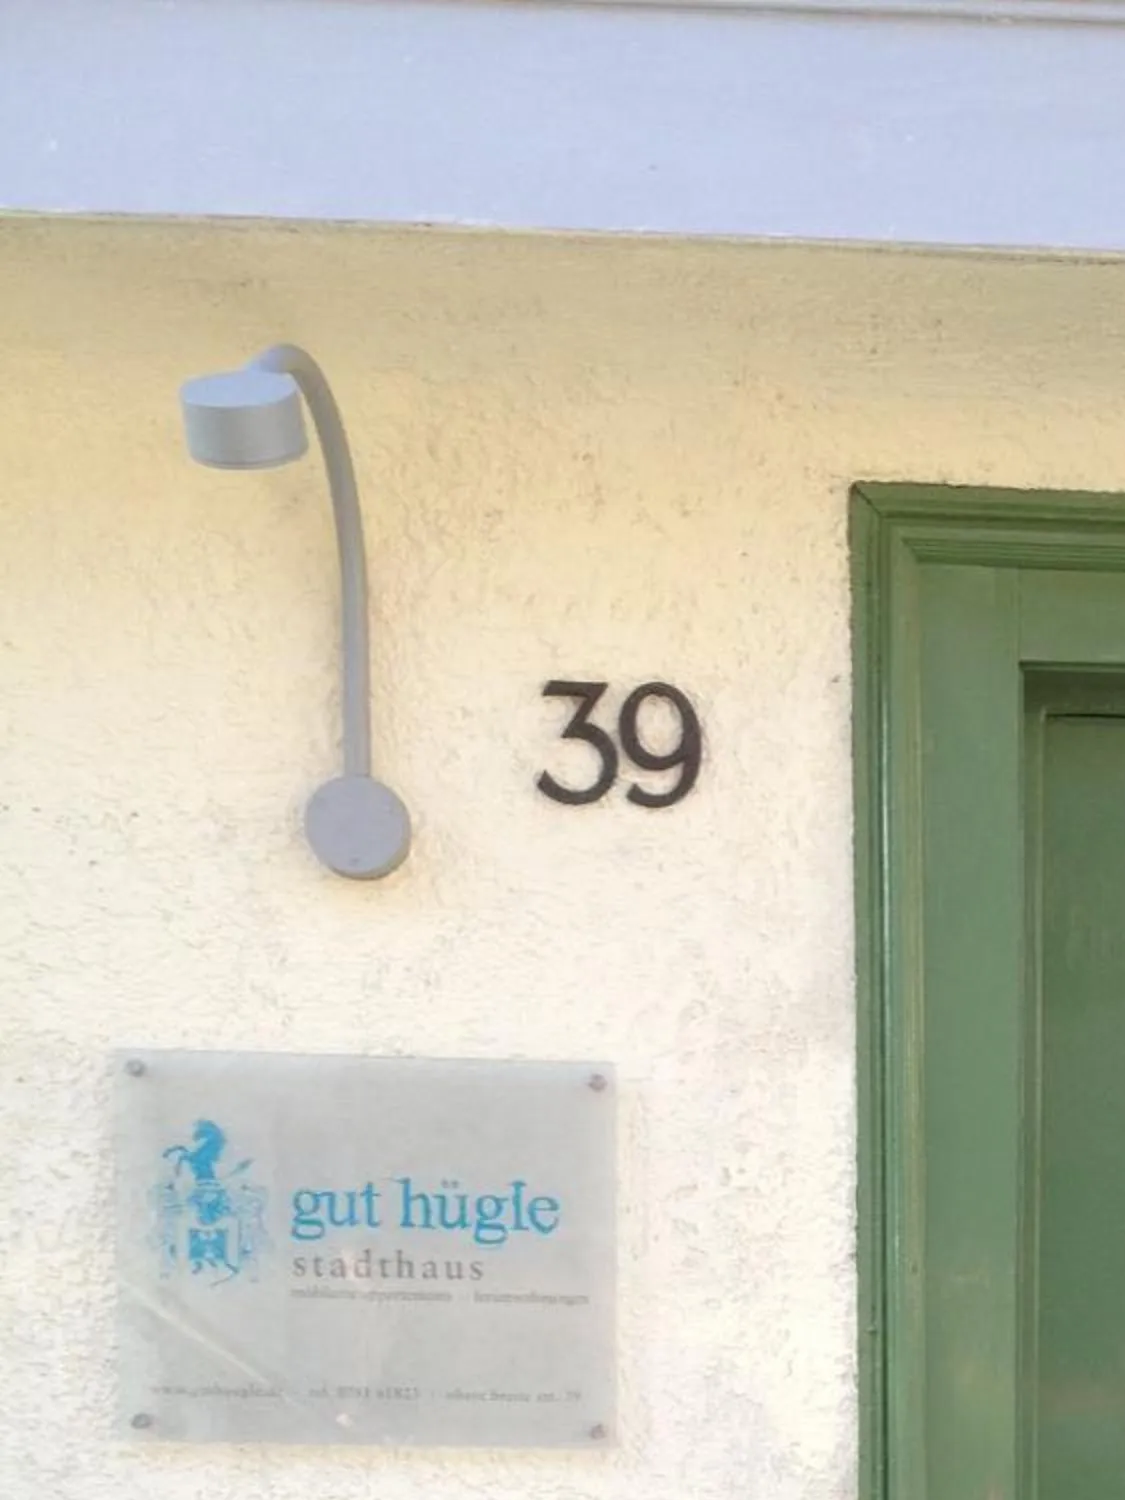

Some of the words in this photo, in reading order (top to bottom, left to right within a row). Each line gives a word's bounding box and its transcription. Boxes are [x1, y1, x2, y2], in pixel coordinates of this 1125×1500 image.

[537, 679, 701, 808] 39
[291, 1181, 382, 1240] gut
[396, 1176, 560, 1245] hügle
[292, 1247, 485, 1281] stadthaus
